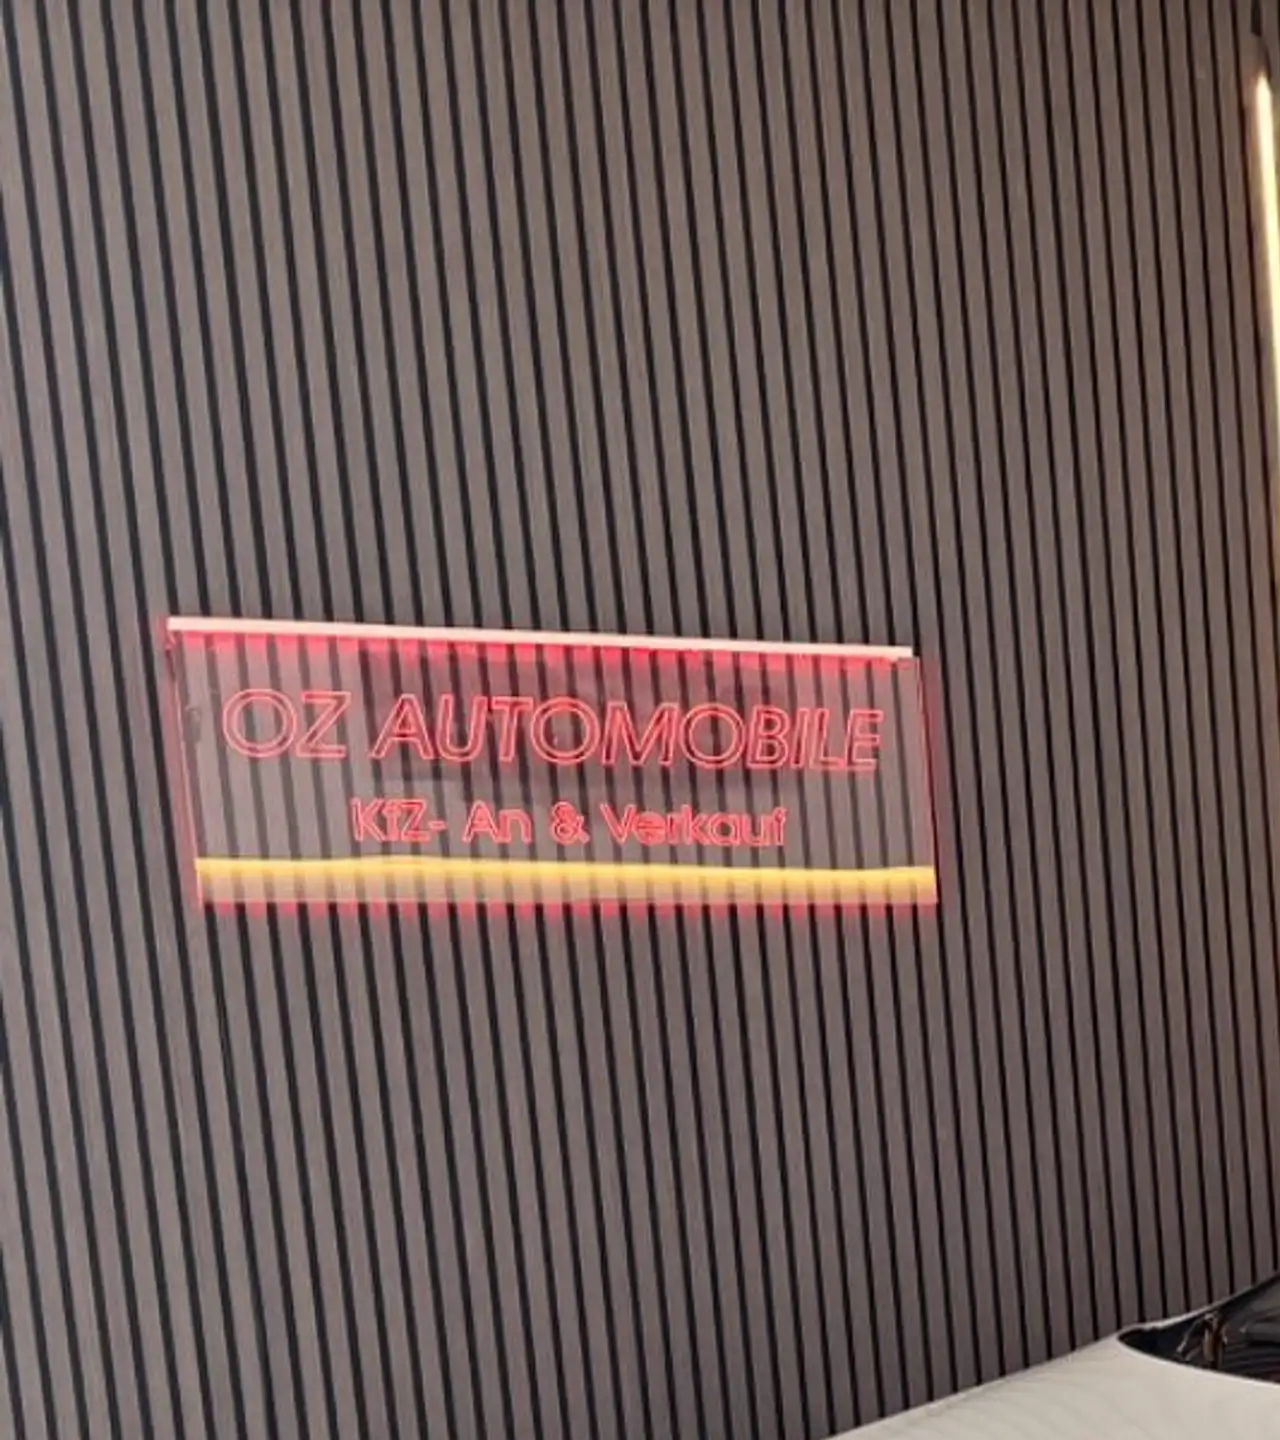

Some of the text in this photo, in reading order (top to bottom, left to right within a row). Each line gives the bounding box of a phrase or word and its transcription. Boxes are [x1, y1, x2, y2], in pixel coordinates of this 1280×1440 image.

[223, 689, 884, 771] OZ AUTOMOBILE
[463, 800, 532, 843] An
[551, 802, 590, 844] &
[600, 803, 787, 847] Verkauf
